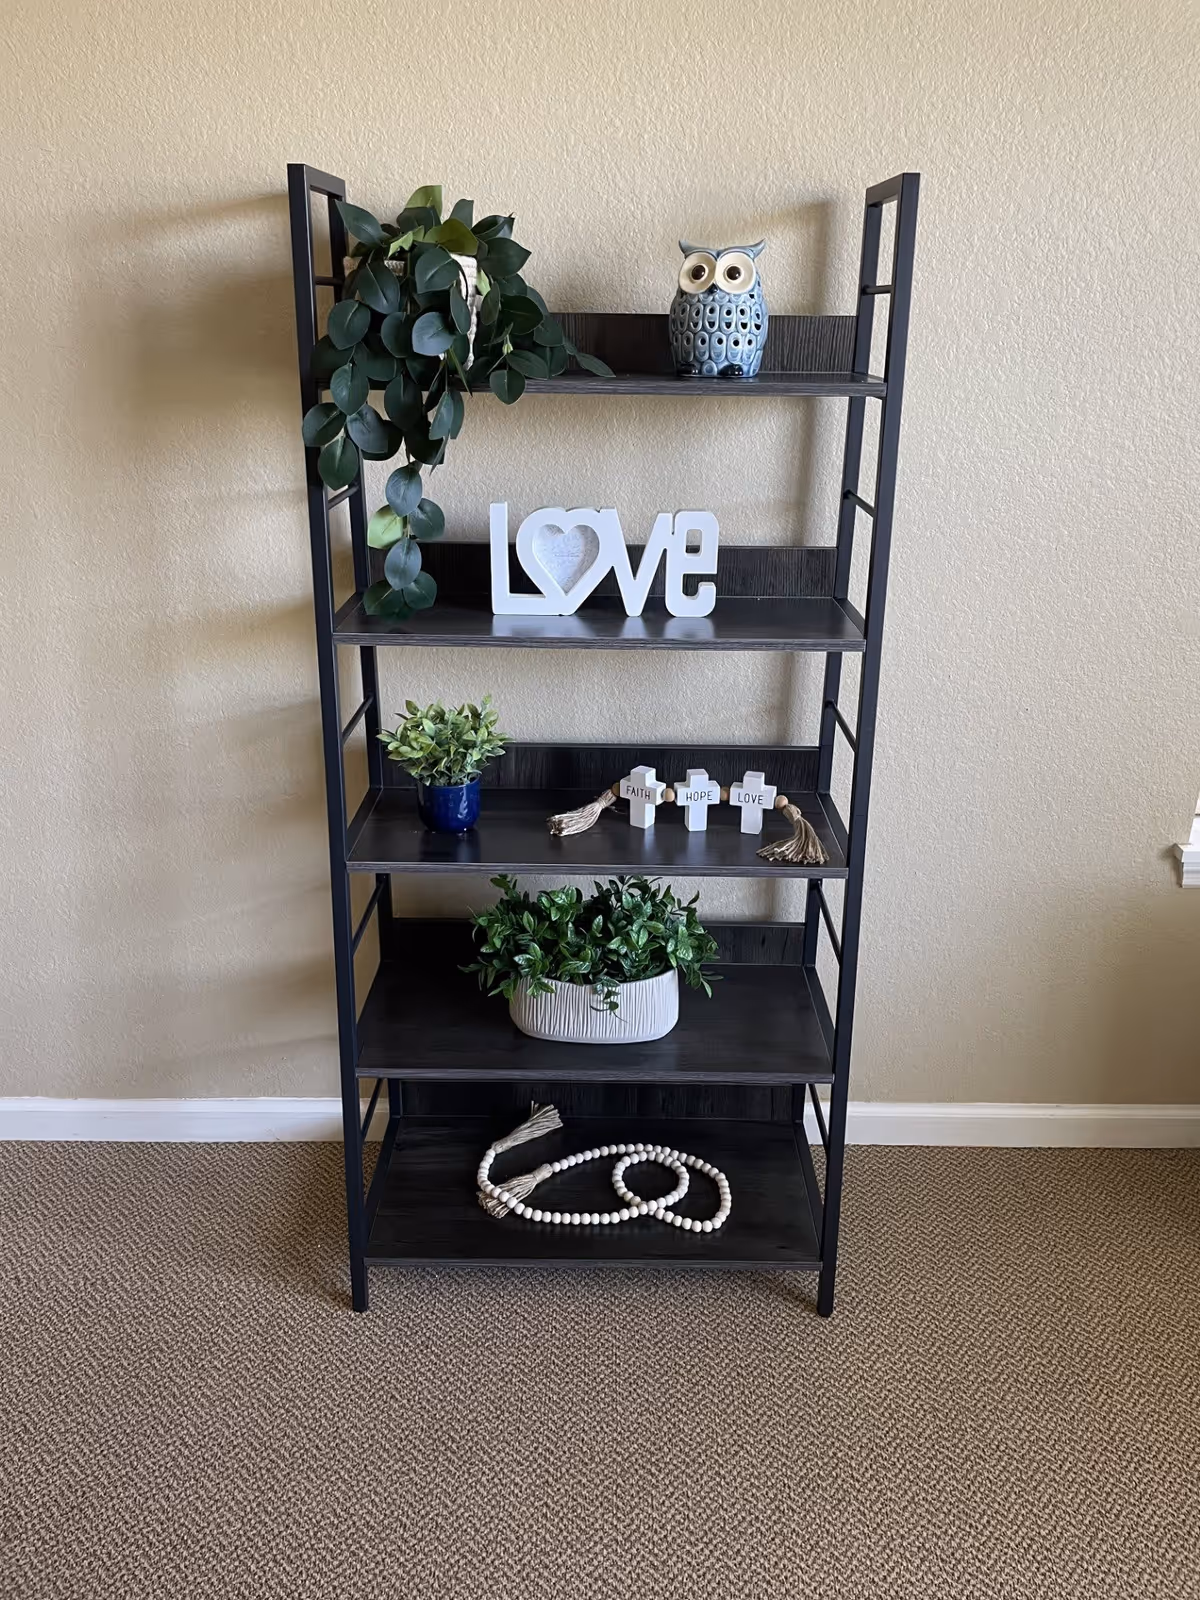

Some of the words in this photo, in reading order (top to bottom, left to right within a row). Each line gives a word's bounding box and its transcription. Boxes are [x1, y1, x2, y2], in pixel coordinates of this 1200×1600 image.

[626, 785, 651, 799] FAITH
[686, 790, 713, 801] HOPE
[737, 793, 763, 805] LOVE
